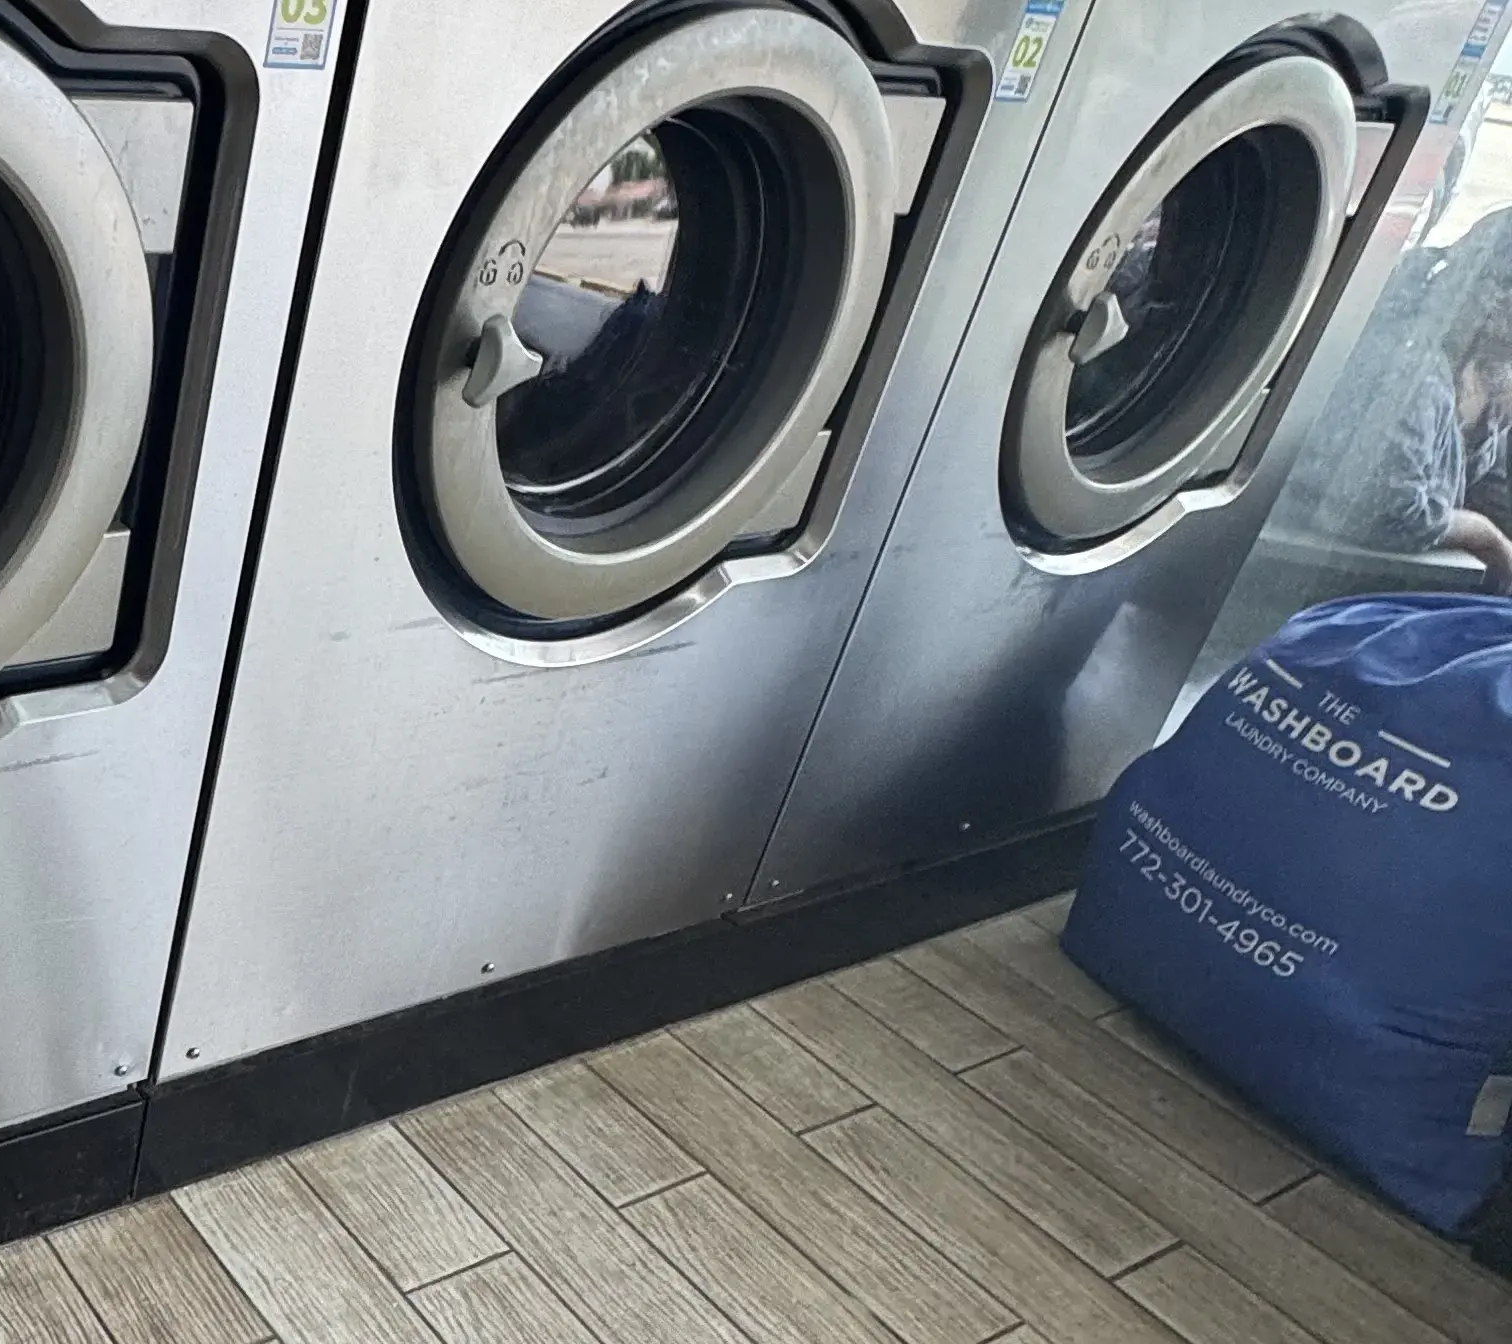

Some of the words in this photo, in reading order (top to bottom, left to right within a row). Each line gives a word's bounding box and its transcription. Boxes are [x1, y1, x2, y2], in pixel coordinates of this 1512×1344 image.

[1011, 35, 1043, 68] 02
[1225, 711, 1294, 765] LAUNDRY
[1292, 758, 1389, 815] COMPANY
[1226, 666, 1460, 813] WASHBOARD
[1317, 689, 1363, 727] THE
[1118, 828, 1305, 977] 772-301-4965
[1129, 800, 1340, 956] washboardlaundryco.com
